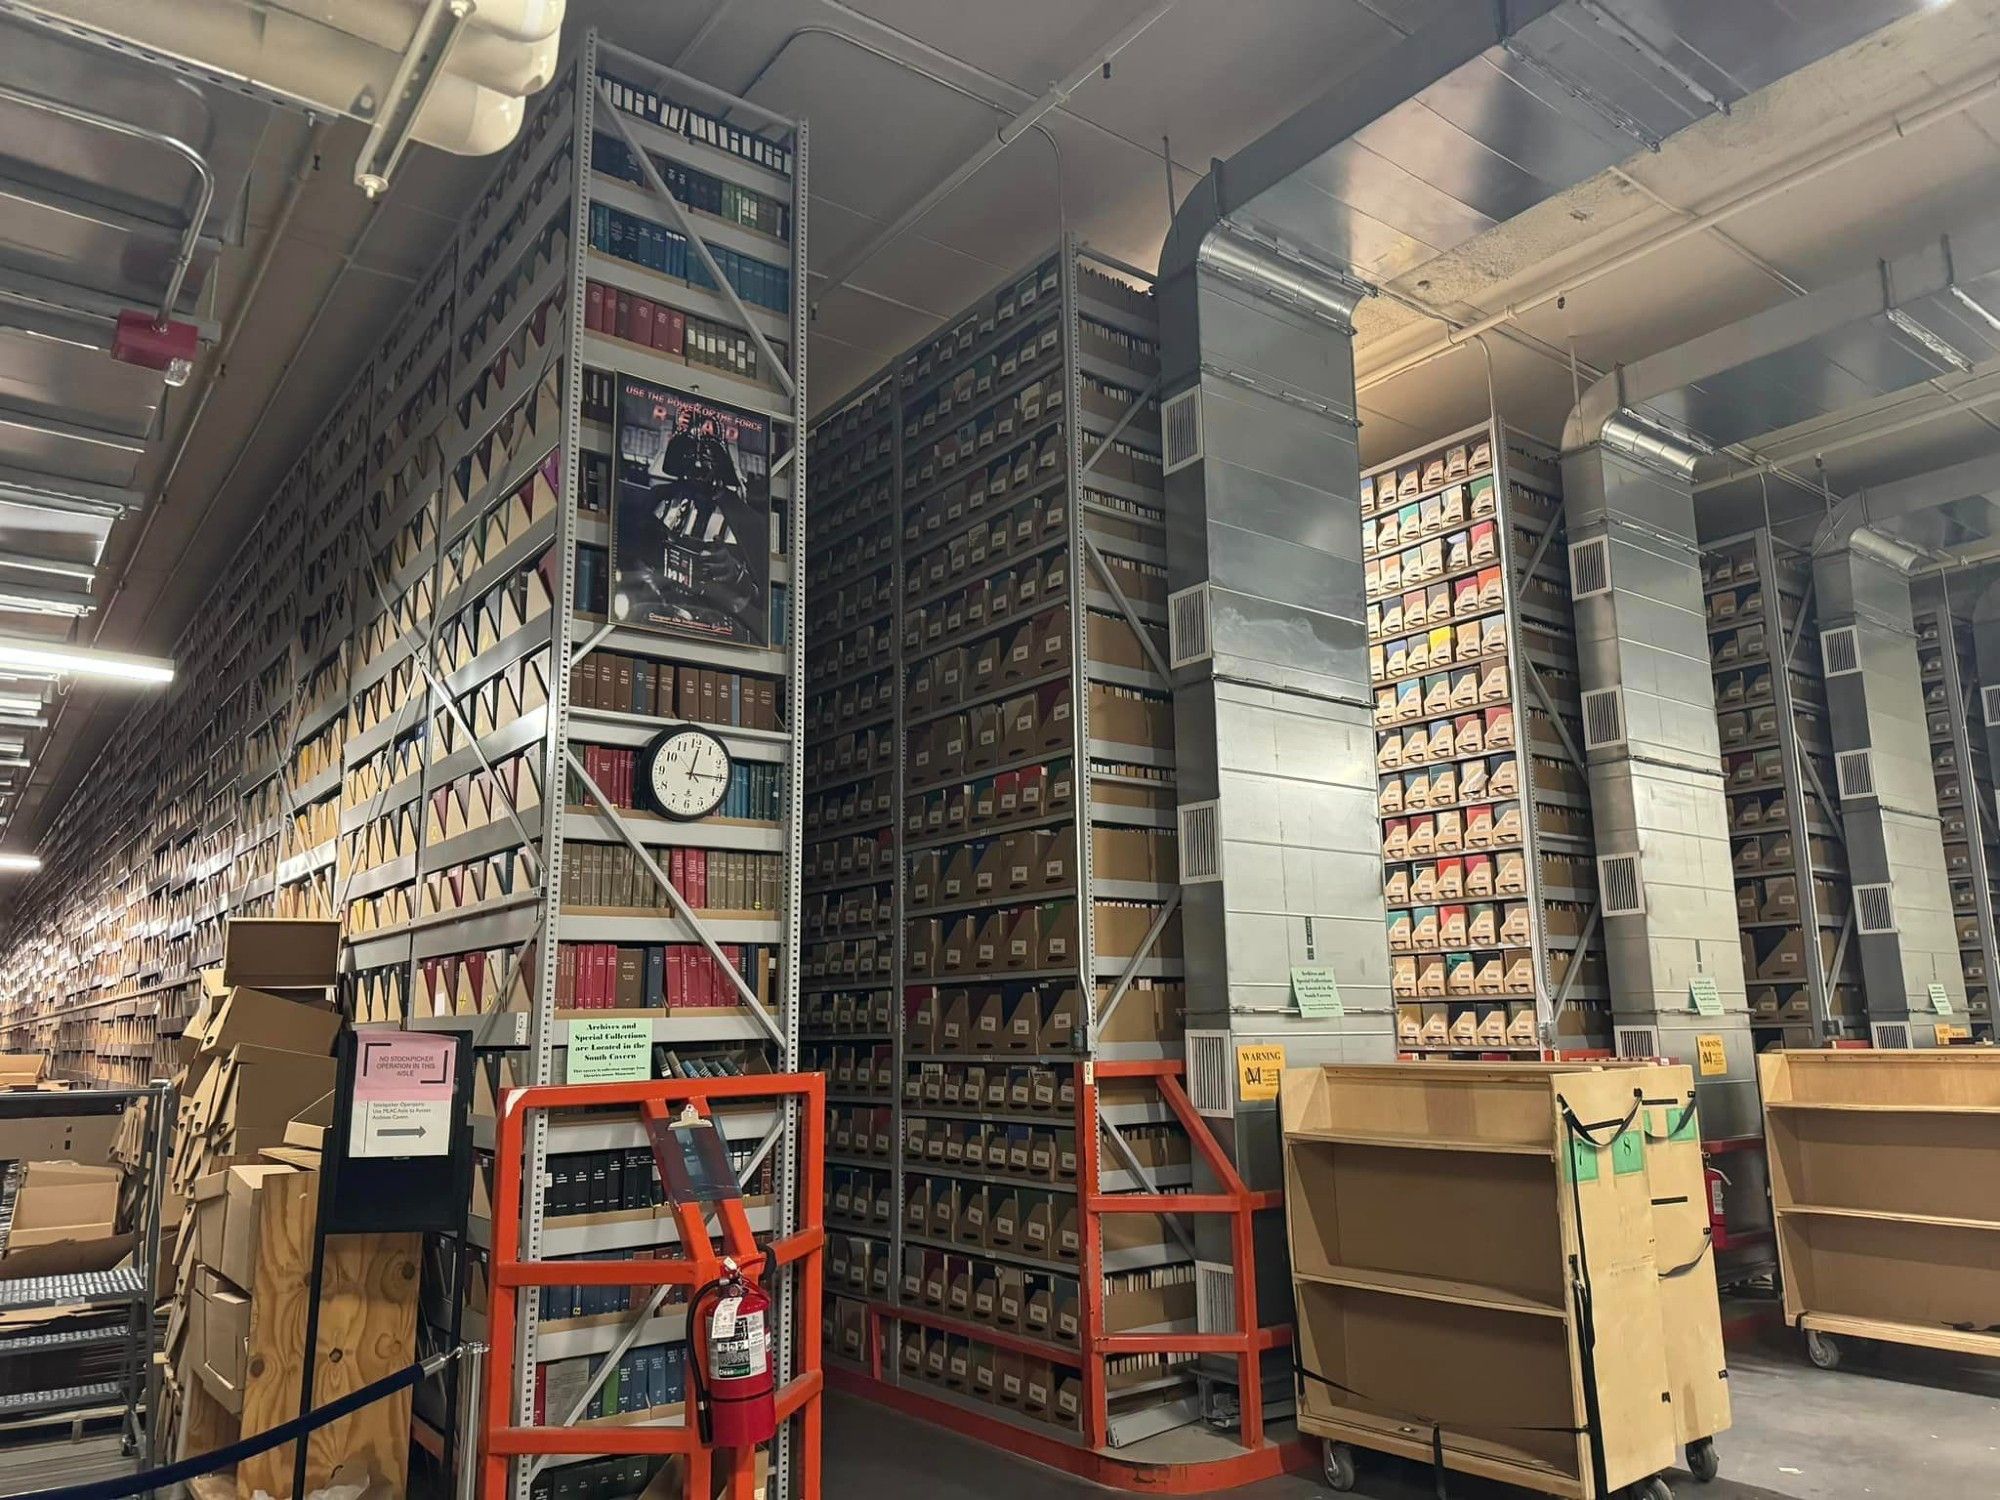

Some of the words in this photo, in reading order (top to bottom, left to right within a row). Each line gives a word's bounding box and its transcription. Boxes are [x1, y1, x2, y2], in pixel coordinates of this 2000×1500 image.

[626, 385, 645, 398] USE
[647, 391, 664, 404] THE
[667, 398, 701, 414] POWER
[702, 407, 716, 417] OF
[717, 411, 733, 424] THE
[735, 416, 763, 432] FORCE
[653, 404, 739, 442] READ
[677, 741, 687, 752] 11
[666, 751, 678, 762] 10
[715, 759, 722, 769] 2
[658, 765, 665, 775] 9
[660, 781, 668, 790] 8
[671, 793, 677, 804] 7
[683, 799, 690, 809] 6
[575, 1034, 603, 1043] Special
[591, 1043, 621, 1051] Located
[1241, 1051, 1281, 1061] WARNING
[1623, 1136, 1632, 1157] 8
